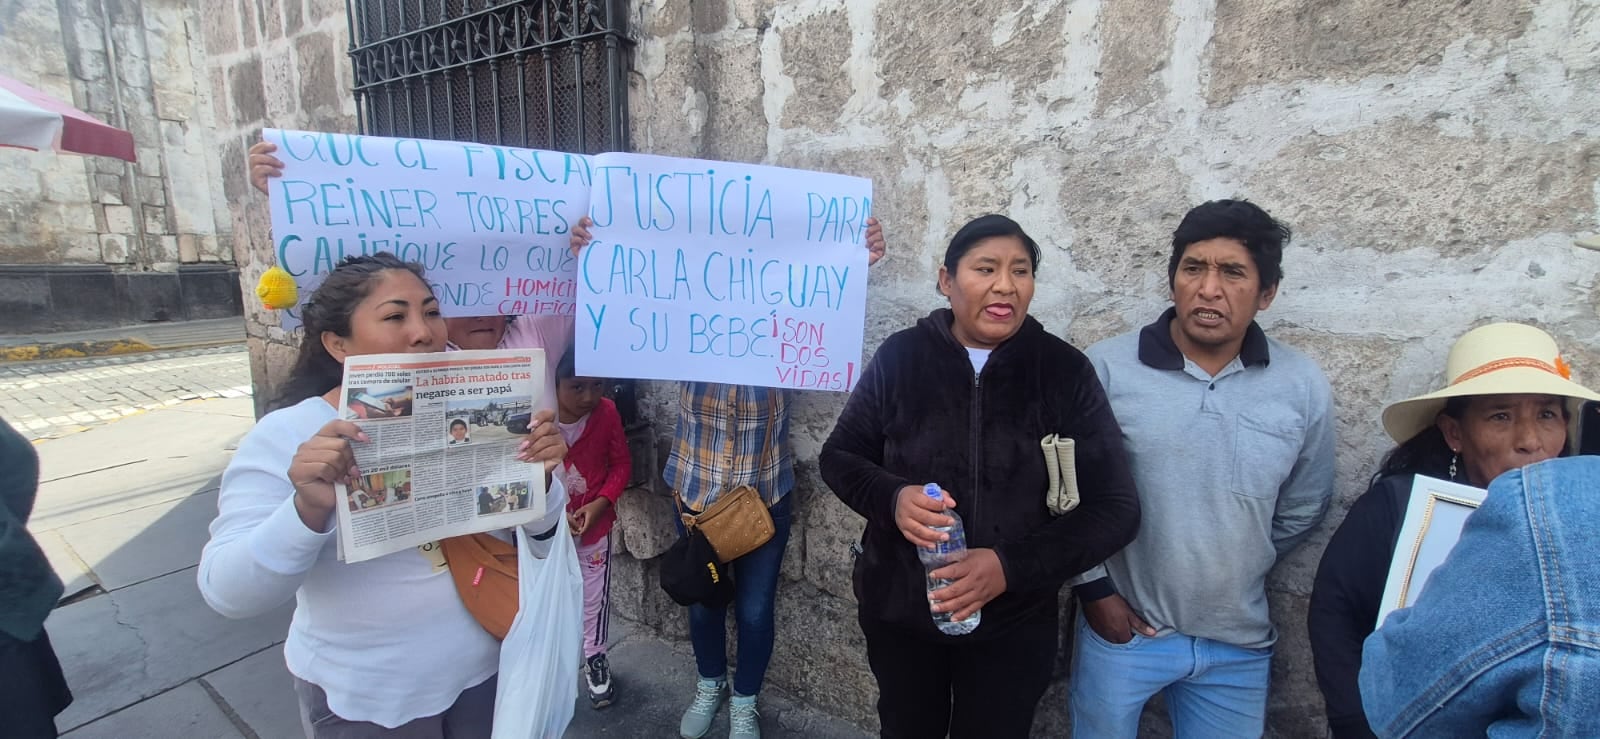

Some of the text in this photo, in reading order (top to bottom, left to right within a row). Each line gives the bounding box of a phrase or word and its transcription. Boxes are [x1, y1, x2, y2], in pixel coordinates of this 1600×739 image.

[280, 176, 570, 235] REINER TORRES
[583, 240, 692, 300] CARLA
[505, 276, 577, 297] HOMICI
[585, 303, 607, 351] Y
[629, 306, 668, 352] SU
[780, 342, 830, 368] DOS
[415, 383, 512, 400] negarse a ser papá
[416, 370, 531, 387] La habría matado tras
